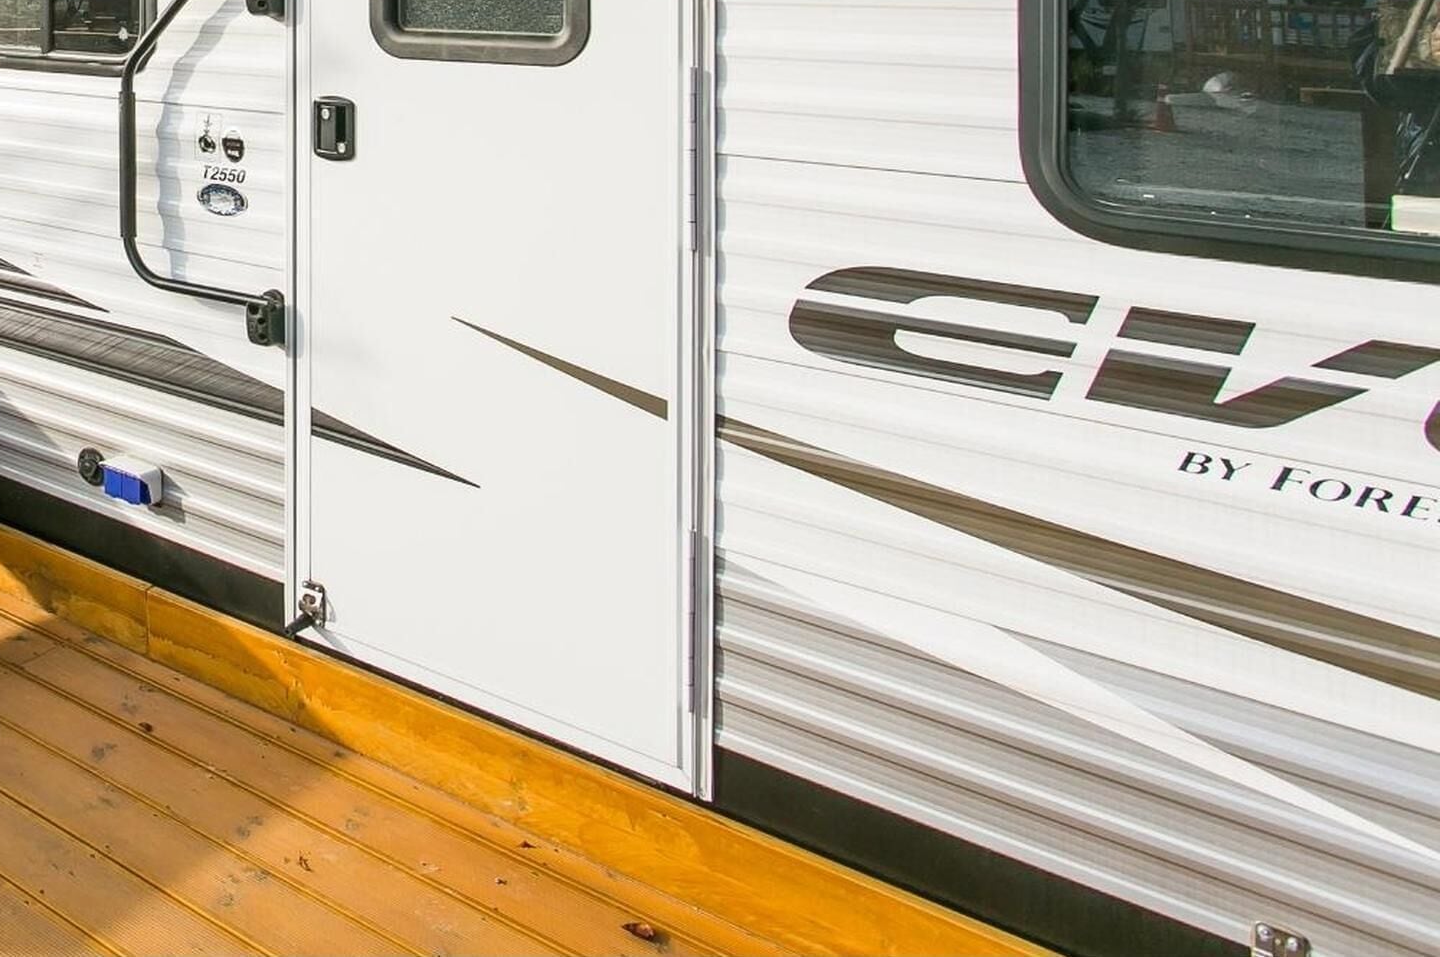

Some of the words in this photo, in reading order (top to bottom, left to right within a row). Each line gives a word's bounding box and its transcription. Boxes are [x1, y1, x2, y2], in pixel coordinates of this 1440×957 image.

[203, 165, 246, 184] T2550
[788, 265, 1440, 453] EV
[1177, 451, 1251, 482] BY
[1269, 466, 1440, 522] FORE
